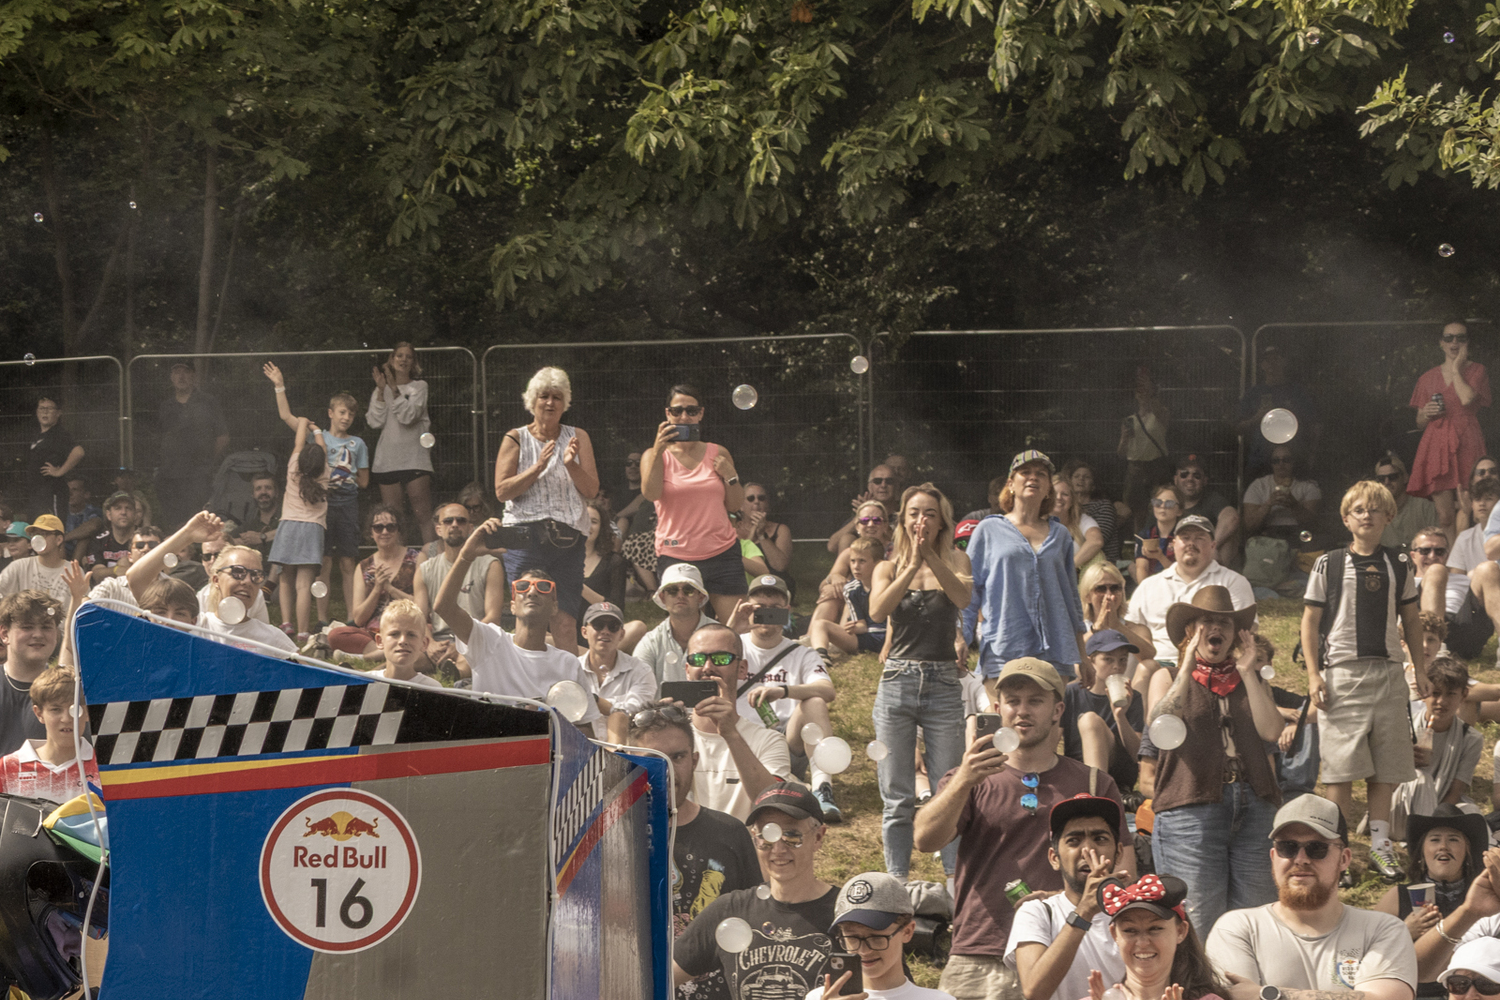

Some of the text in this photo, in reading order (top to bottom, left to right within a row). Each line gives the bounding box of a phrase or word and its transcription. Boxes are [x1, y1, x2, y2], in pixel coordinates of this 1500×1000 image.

[293, 845, 387, 869] Red Bull
[311, 877, 374, 929] 16
[740, 945, 826, 972] CHEVROLET
